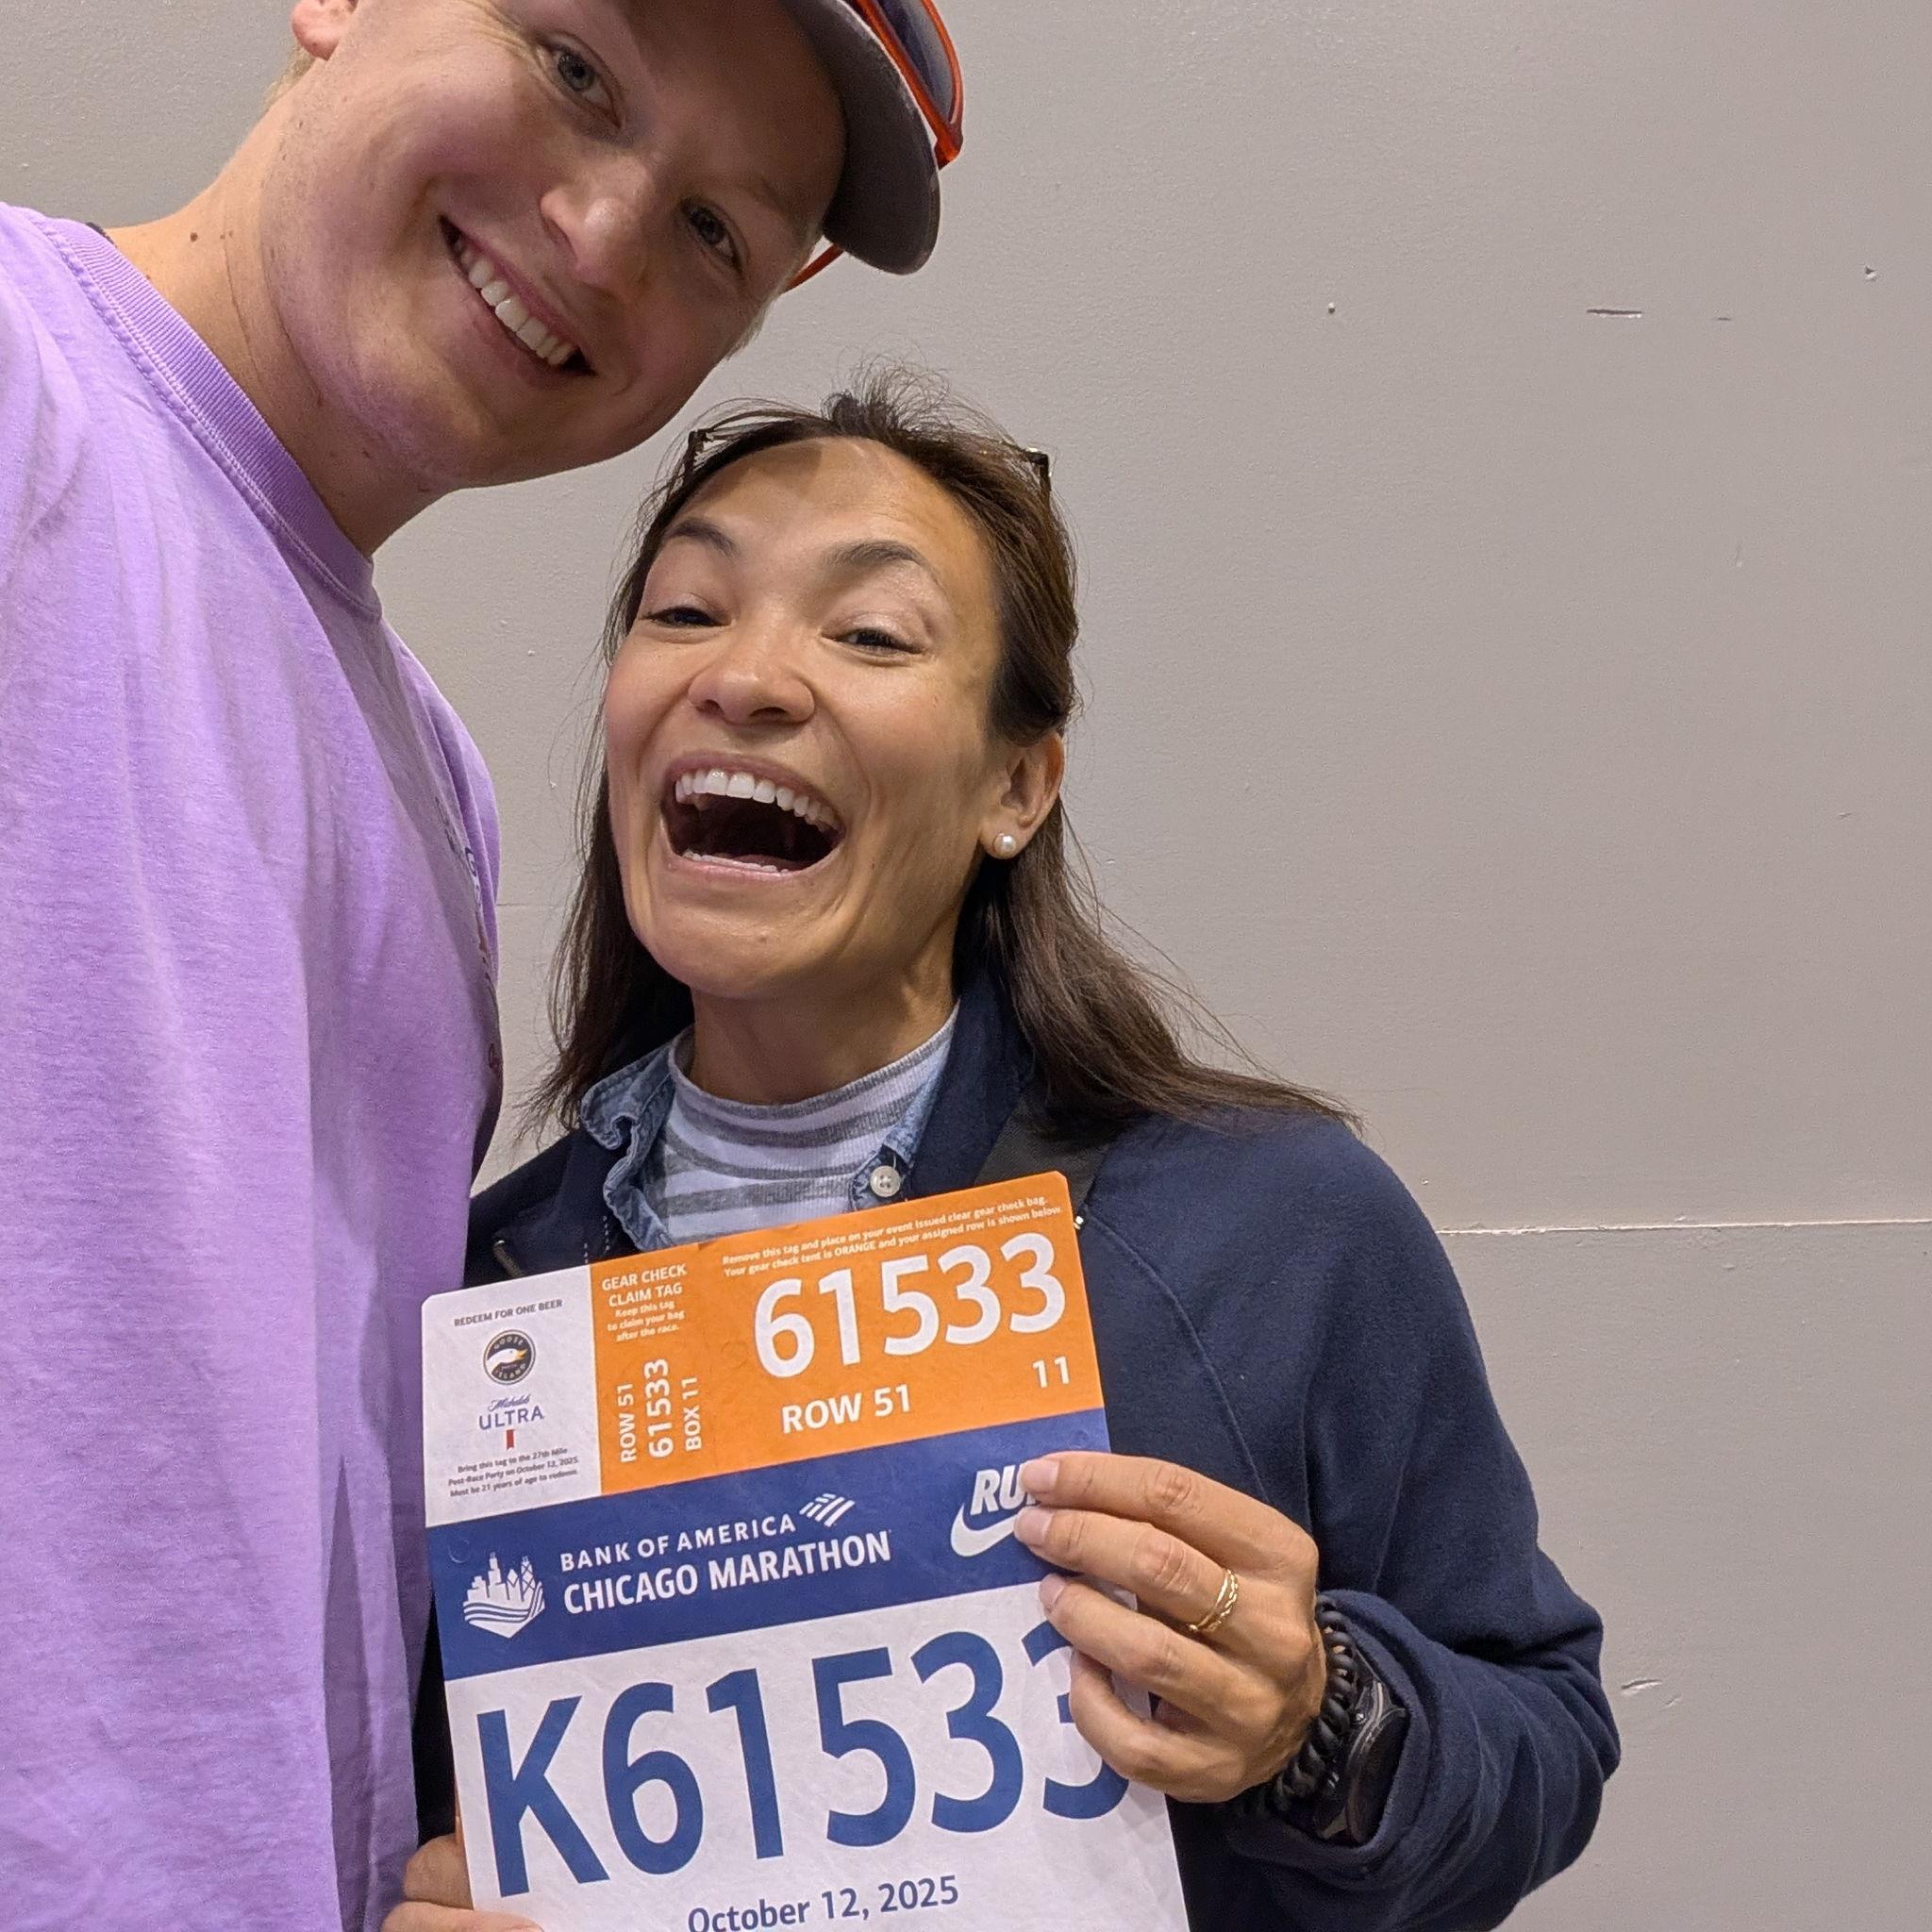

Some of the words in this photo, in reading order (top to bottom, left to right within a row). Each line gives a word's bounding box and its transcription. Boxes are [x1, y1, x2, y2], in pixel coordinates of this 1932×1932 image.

[723, 1251, 760, 1265] Remove
[762, 1248, 781, 1259] this
[784, 1244, 799, 1256] tag
[802, 1238, 819, 1251] and
[821, 1235, 846, 1251] place
[849, 1232, 860, 1241] on
[862, 1227, 884, 1241] your
[886, 1222, 913, 1235] event
[915, 1214, 946, 1229] issued
[948, 1209, 973, 1223] clear
[974, 1206, 995, 1221] gear
[997, 1199, 1024, 1212] check
[724, 1265, 746, 1277] Your
[748, 1261, 769, 1275] gear
[772, 1256, 800, 1270] check
[802, 1251, 822, 1262] tent
[824, 1248, 833, 1259] is
[834, 1241, 876, 1257] ORANGE
[878, 1236, 896, 1249] and
[898, 1233, 920, 1247] your
[922, 1223, 964, 1240] assigned
[965, 1220, 986, 1232] row
[987, 1217, 996, 1227] is
[998, 1212, 1030, 1225] shown
[602, 1274, 638, 1291] GEAR
[641, 1263, 688, 1283] CHECK
[608, 1288, 652, 1307] CLAIM
[655, 1282, 683, 1298] TAG
[615, 1307, 638, 1318] Keep
[641, 1302, 658, 1312] this
[659, 1300, 675, 1310] tag
[754, 1232, 1067, 1378] 61533
[454, 1312, 492, 1327] REDEEM
[494, 1308, 513, 1320] FOR
[515, 1304, 536, 1315] ONE
[539, 1299, 563, 1311] BEER
[607, 1323, 618, 1332] to
[619, 1317, 644, 1330] claim
[645, 1312, 666, 1326] your
[667, 1309, 686, 1322] bag
[616, 1329, 639, 1342] after
[641, 1325, 656, 1337] the
[681, 1377, 699, 1400] 11
[1032, 1356, 1072, 1390] 11
[617, 1383, 634, 1407] 51
[643, 1358, 674, 1458] 61533
[781, 1391, 862, 1434] ROW
[874, 1384, 911, 1418] 51
[479, 1405, 544, 1430] ULTRA
[683, 1404, 702, 1452] BOX
[619, 1412, 638, 1463] ROW
[448, 1474, 484, 1487] Post-Race
[485, 1470, 504, 1480] Party
[516, 1462, 545, 1475] October
[559, 1456, 578, 1466] 2025
[458, 1463, 477, 1474] Bring
[479, 1460, 492, 1470] this
[495, 1458, 507, 1468] tag
[519, 1454, 530, 1463] the
[533, 1450, 550, 1459] 27th
[552, 1447, 568, 1457] Mile
[450, 1488, 469, 1497] Must
[471, 1486, 480, 1494] be
[481, 1483, 491, 1492] 21
[492, 1480, 512, 1492] years
[514, 1477, 523, 1487] of
[525, 1475, 538, 1486] age
[970, 1464, 1036, 1516] RU
[560, 1541, 631, 1572] BANK
[637, 1534, 669, 1558] OF
[676, 1513, 796, 1553] AMERICA
[563, 1563, 699, 1615] CHICAGO
[708, 1530, 891, 1591] MARATHON
[688, 1898, 810, 1932] October
[821, 1888, 870, 1922] 12,
[877, 1874, 959, 1913] 2025
